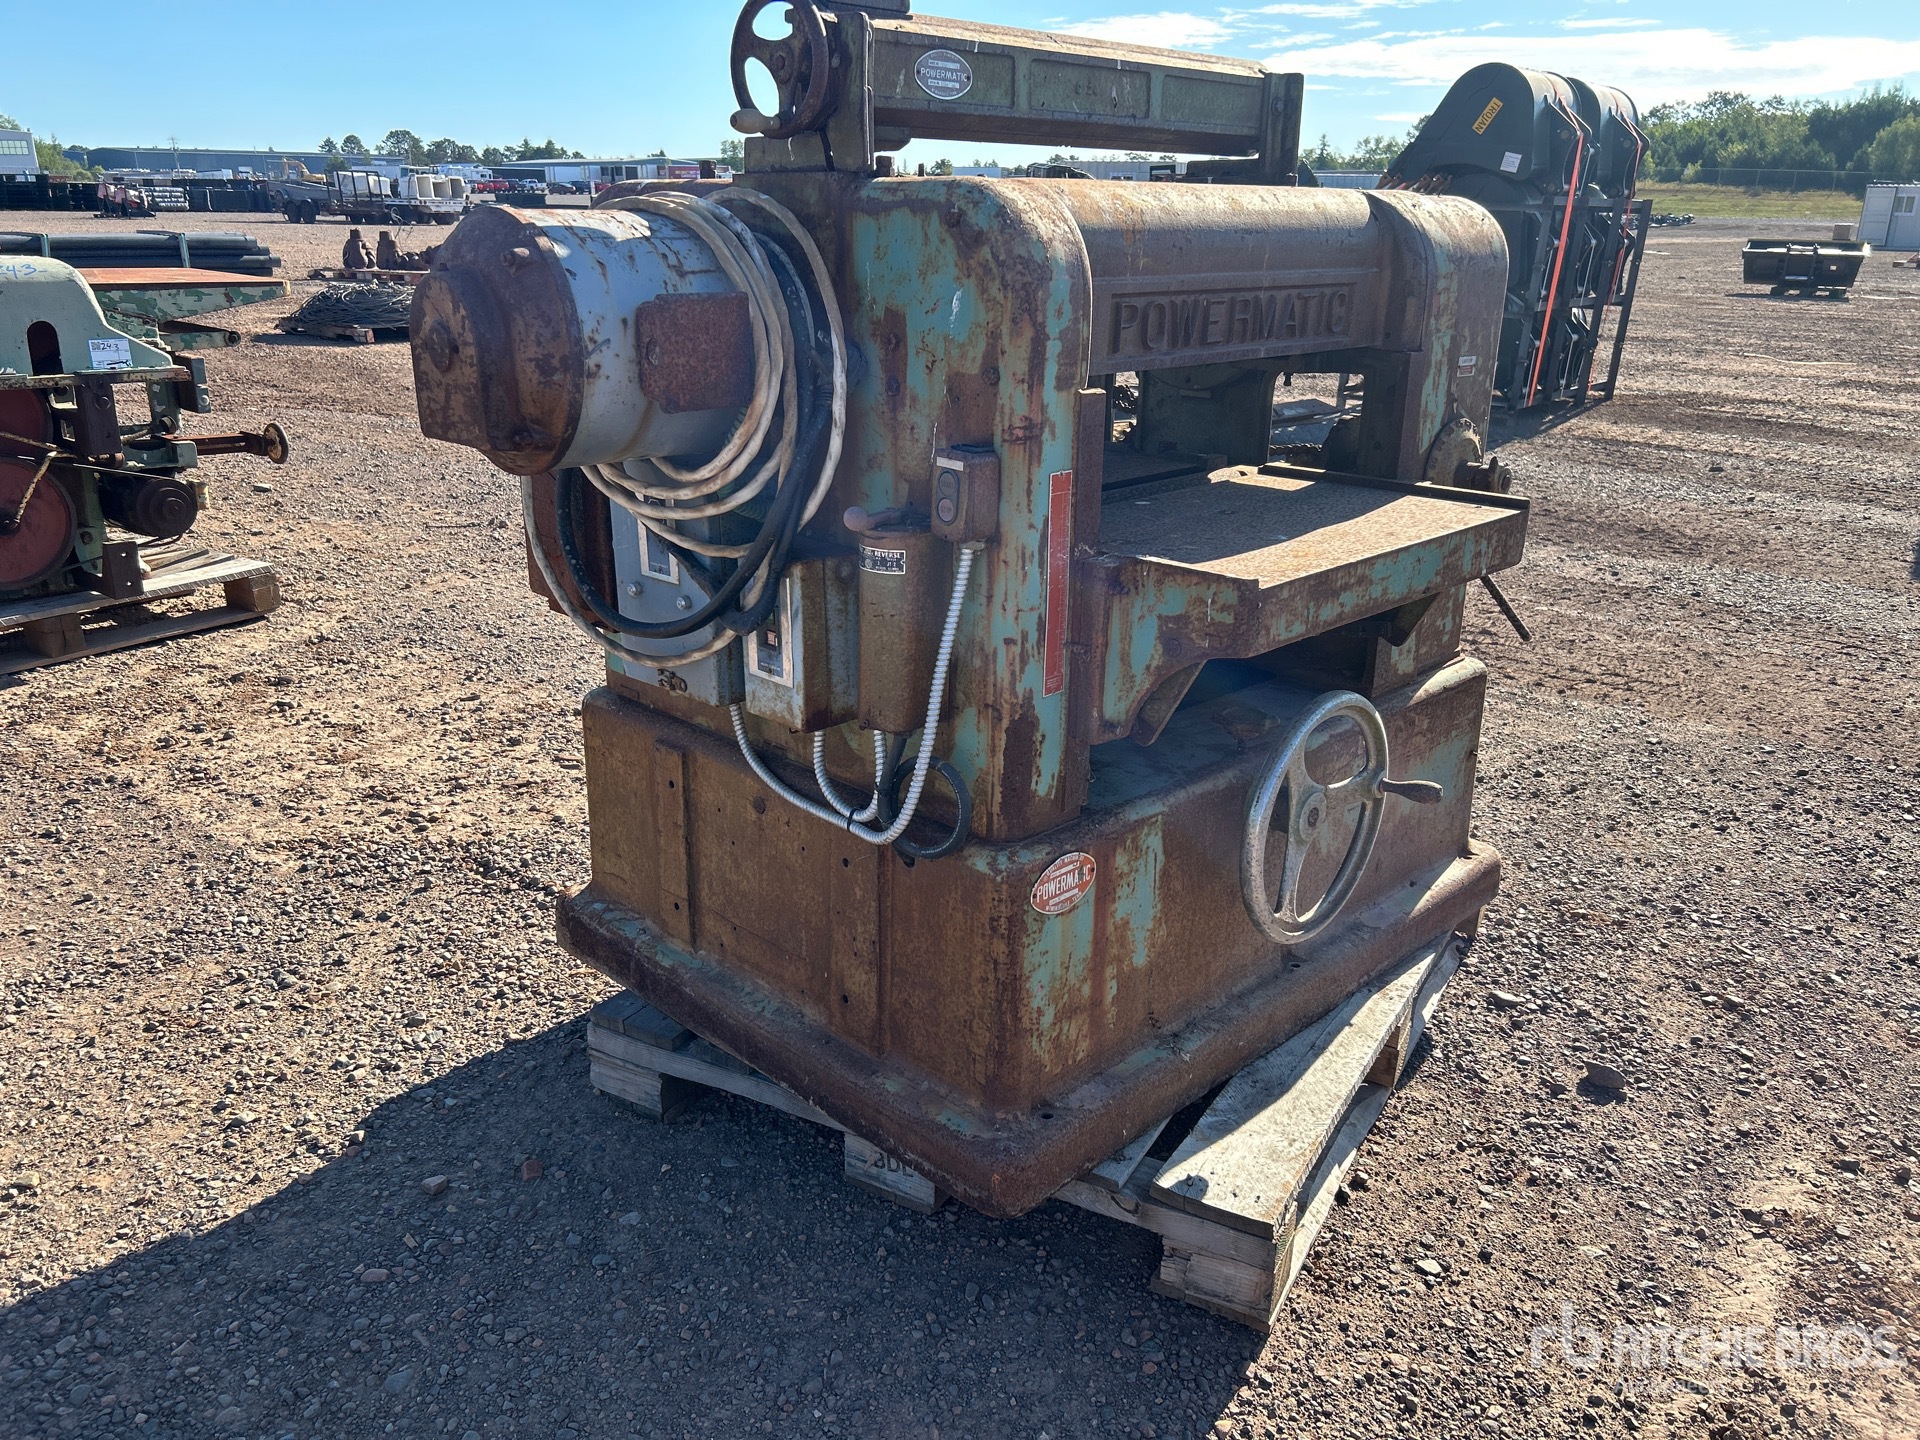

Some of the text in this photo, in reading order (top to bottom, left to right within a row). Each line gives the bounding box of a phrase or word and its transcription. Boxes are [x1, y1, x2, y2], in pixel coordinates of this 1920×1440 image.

[920, 67, 968, 82] POWERMATIC
[1474, 102, 1501, 133] TROJAN
[1108, 290, 1348, 353] POWERMATIC
[1036, 864, 1091, 903] POWERMAIC
